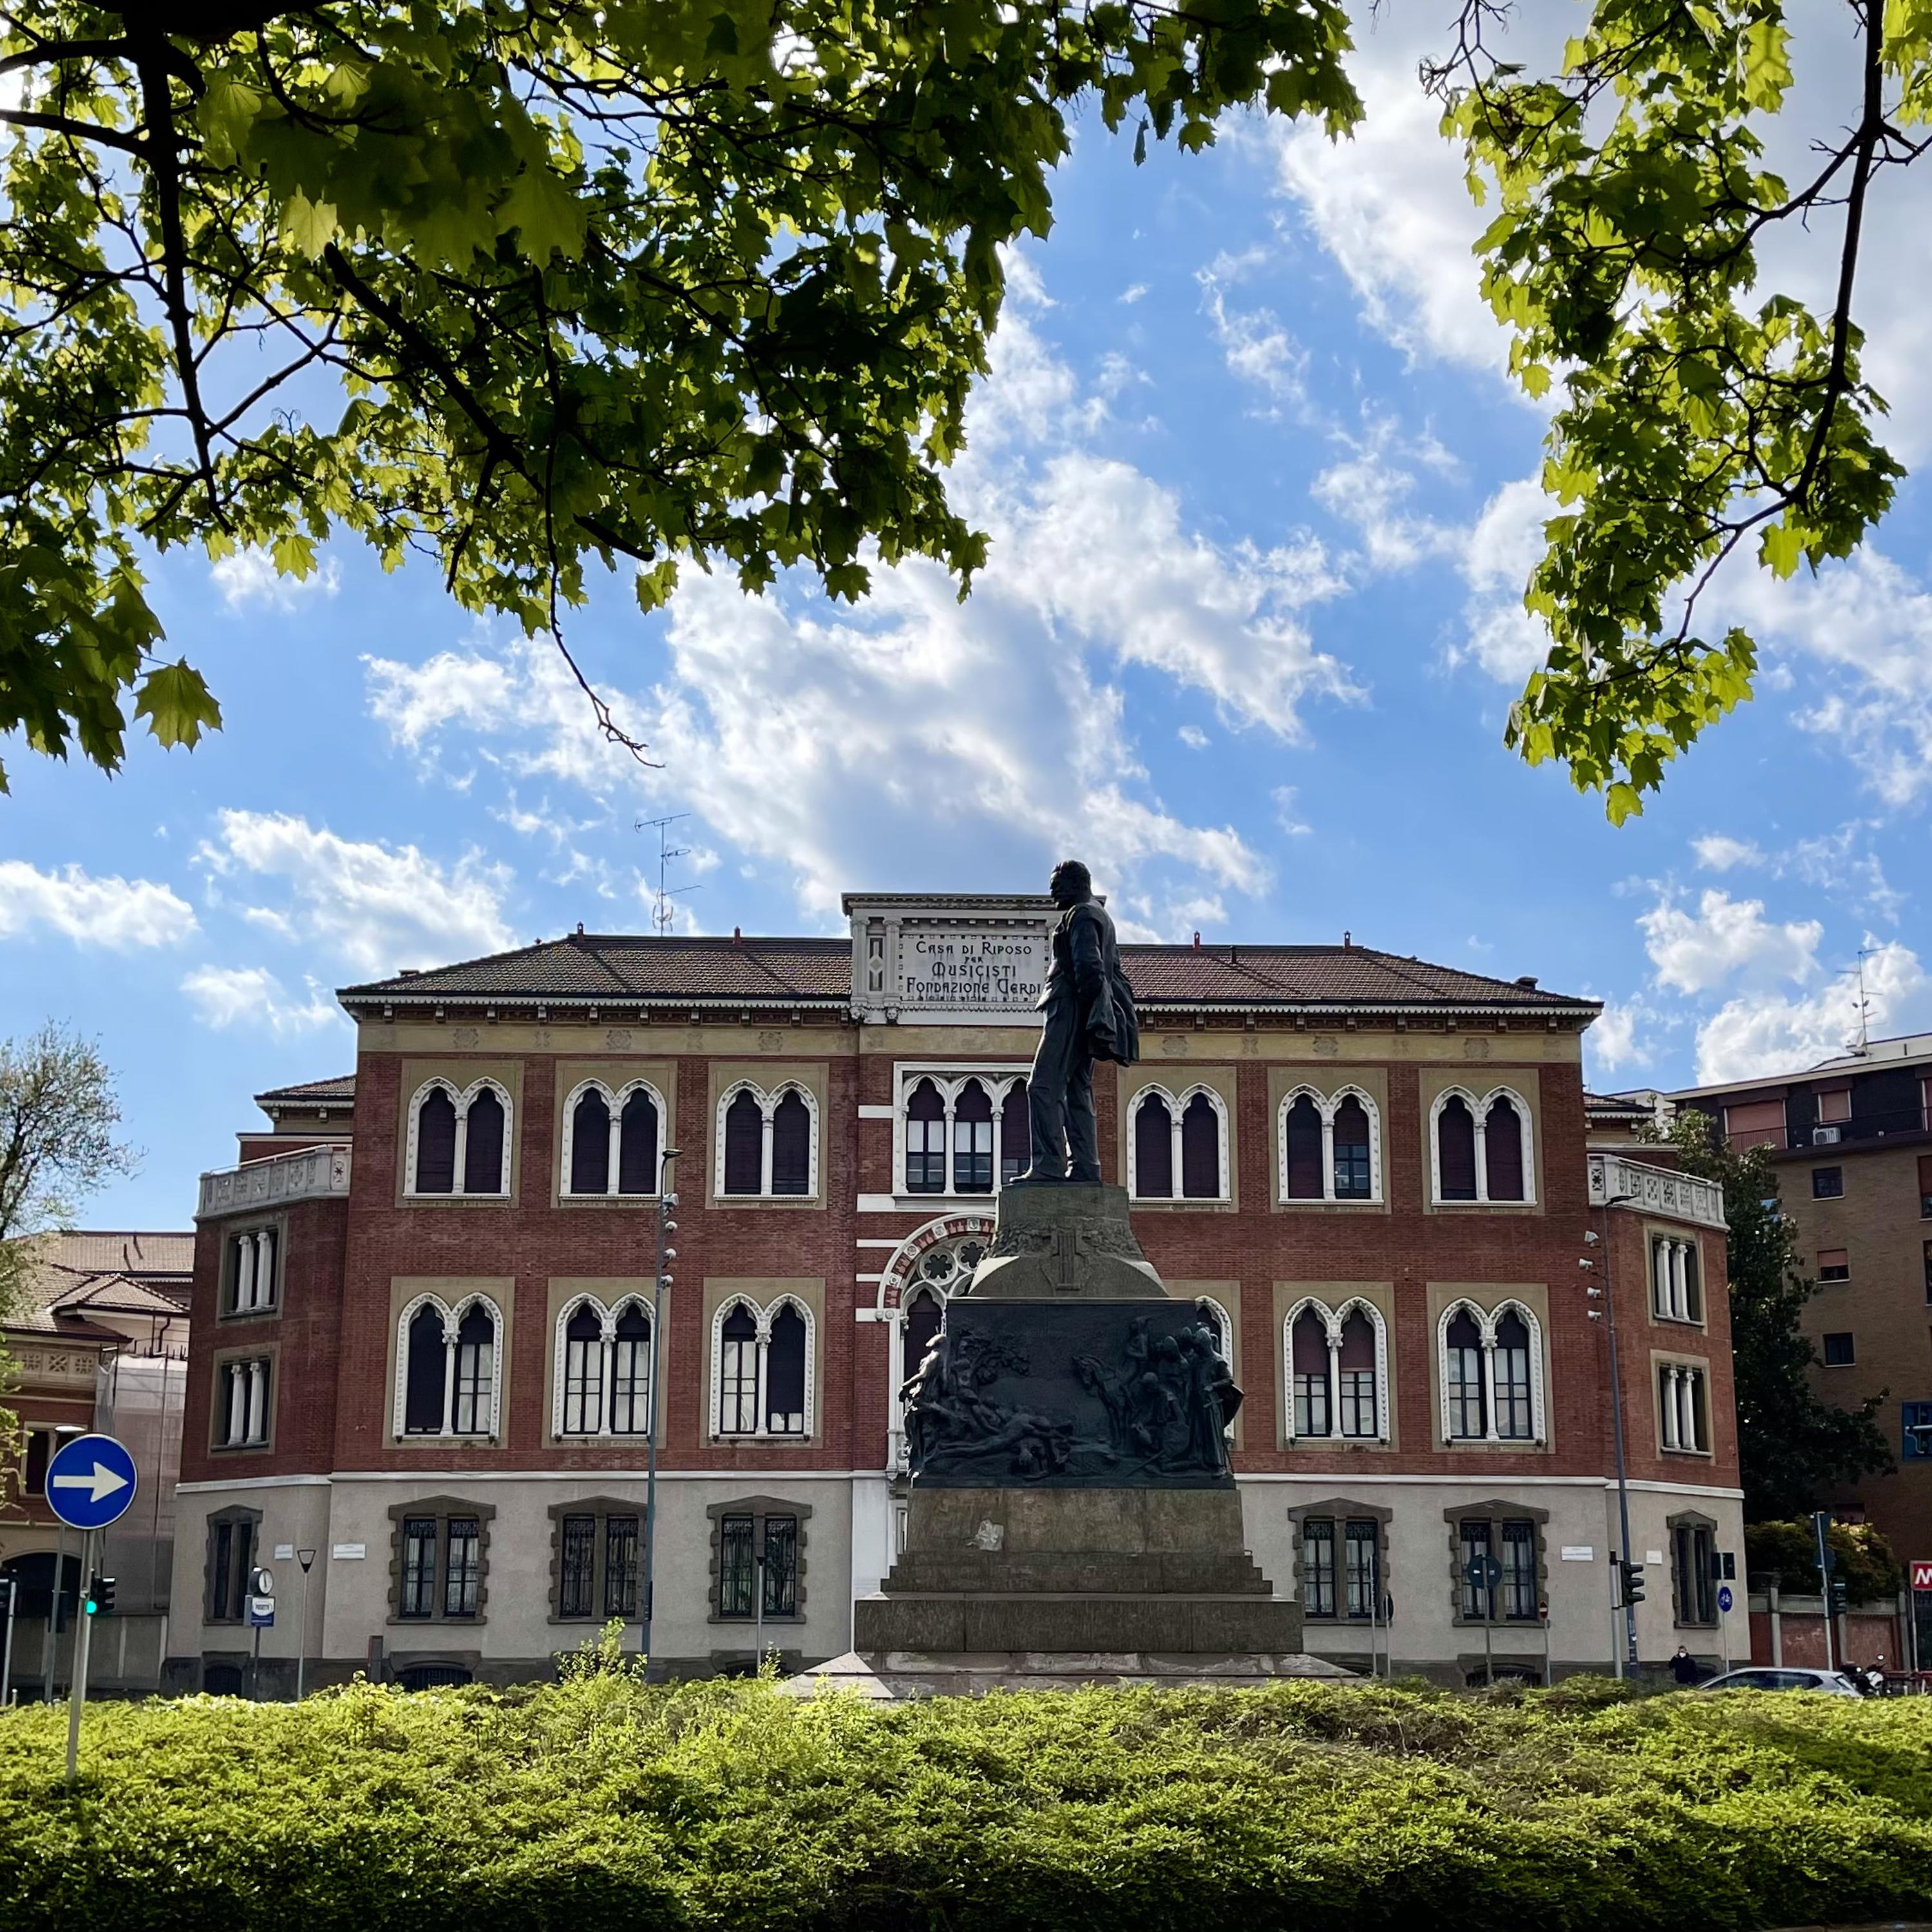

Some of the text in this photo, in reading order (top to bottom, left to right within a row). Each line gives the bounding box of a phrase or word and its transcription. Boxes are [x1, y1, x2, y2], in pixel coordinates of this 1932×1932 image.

[916, 941, 1032, 955] CASA DI RIPOSO
[932, 961, 1016, 978] MUSICISTI
[907, 977, 1041, 995] FONDAZIONE VERDI
